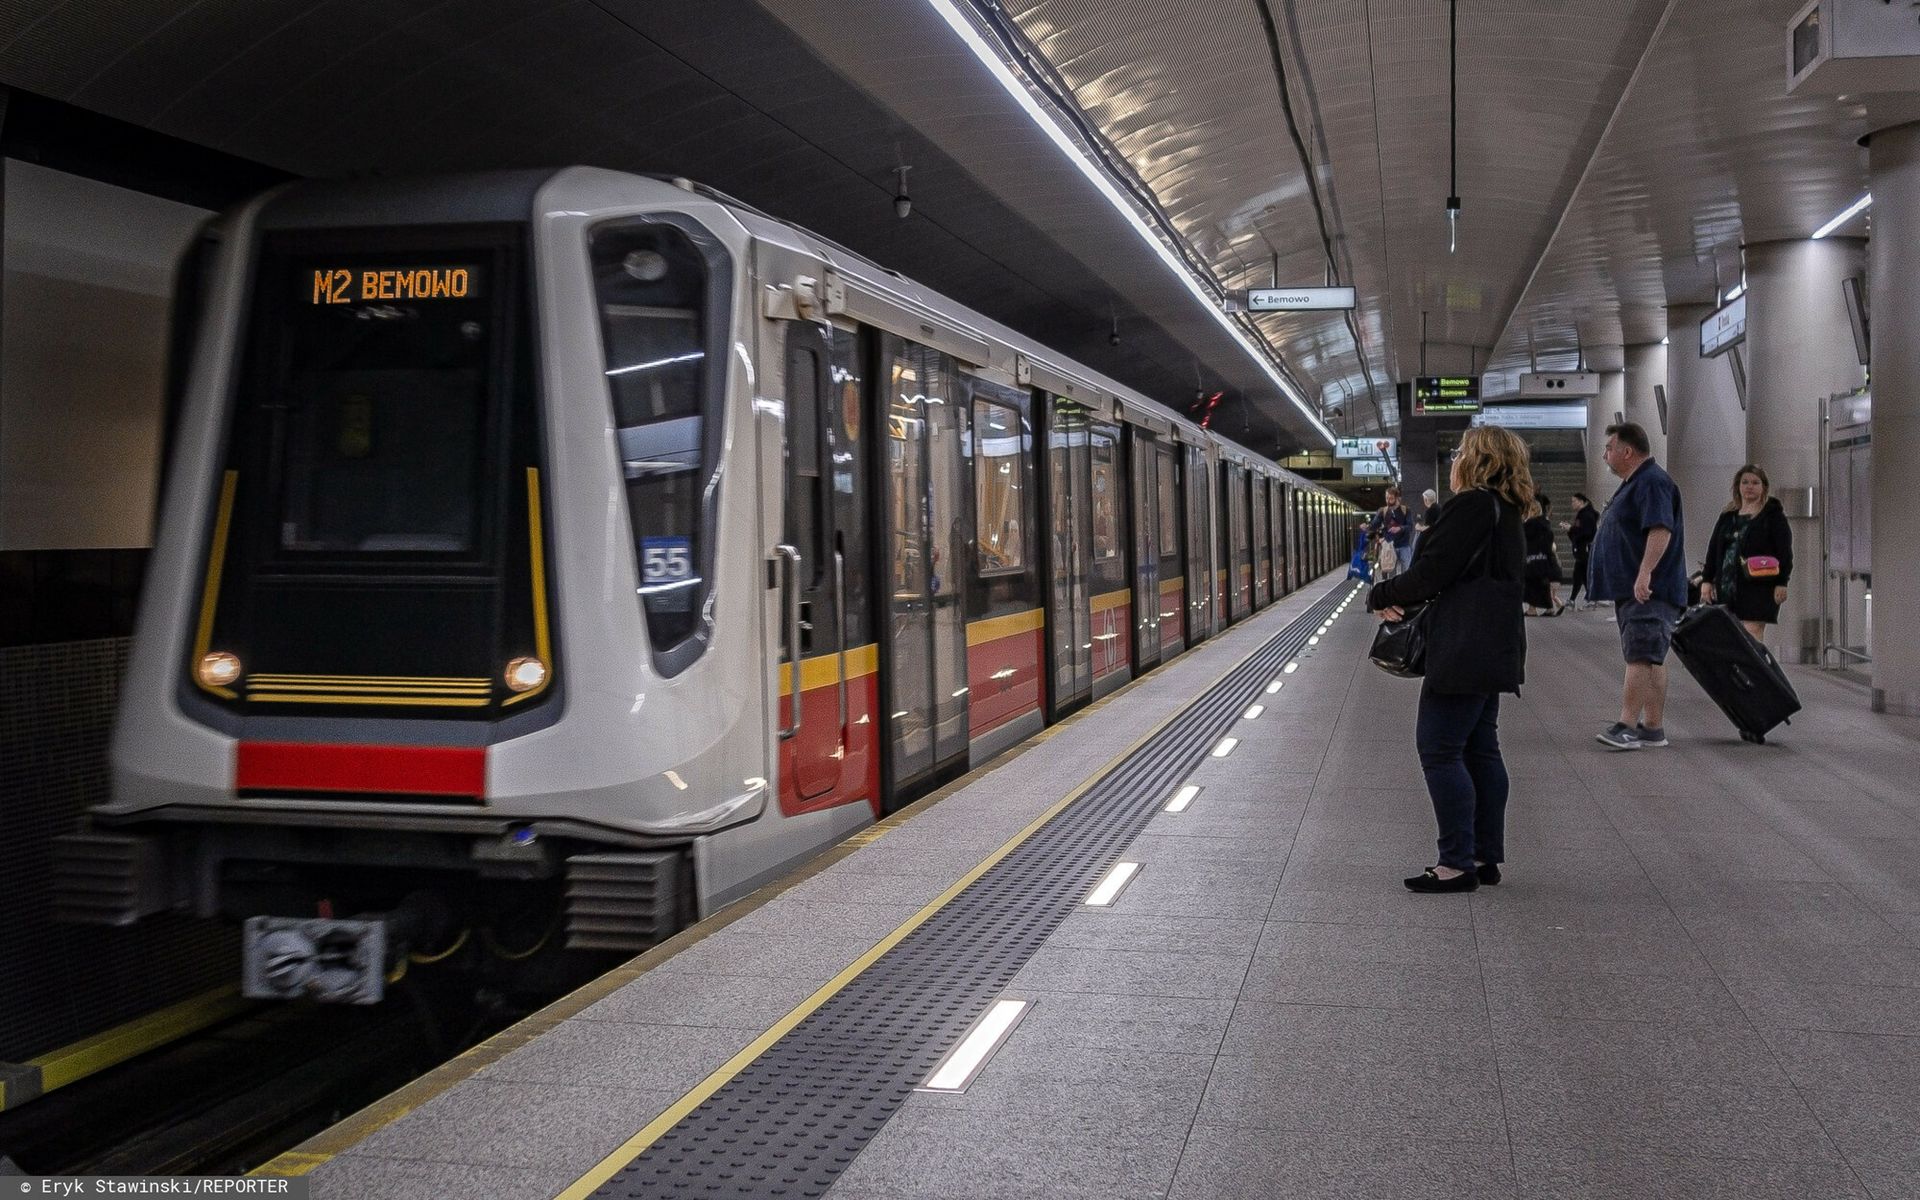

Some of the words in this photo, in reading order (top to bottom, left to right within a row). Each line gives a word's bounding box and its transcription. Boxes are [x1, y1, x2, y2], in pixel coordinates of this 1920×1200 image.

[313, 269, 352, 304] M2
[362, 269, 468, 299] BEMOWO
[1267, 295, 1310, 304] Bemowo
[643, 547, 690, 577] 55
